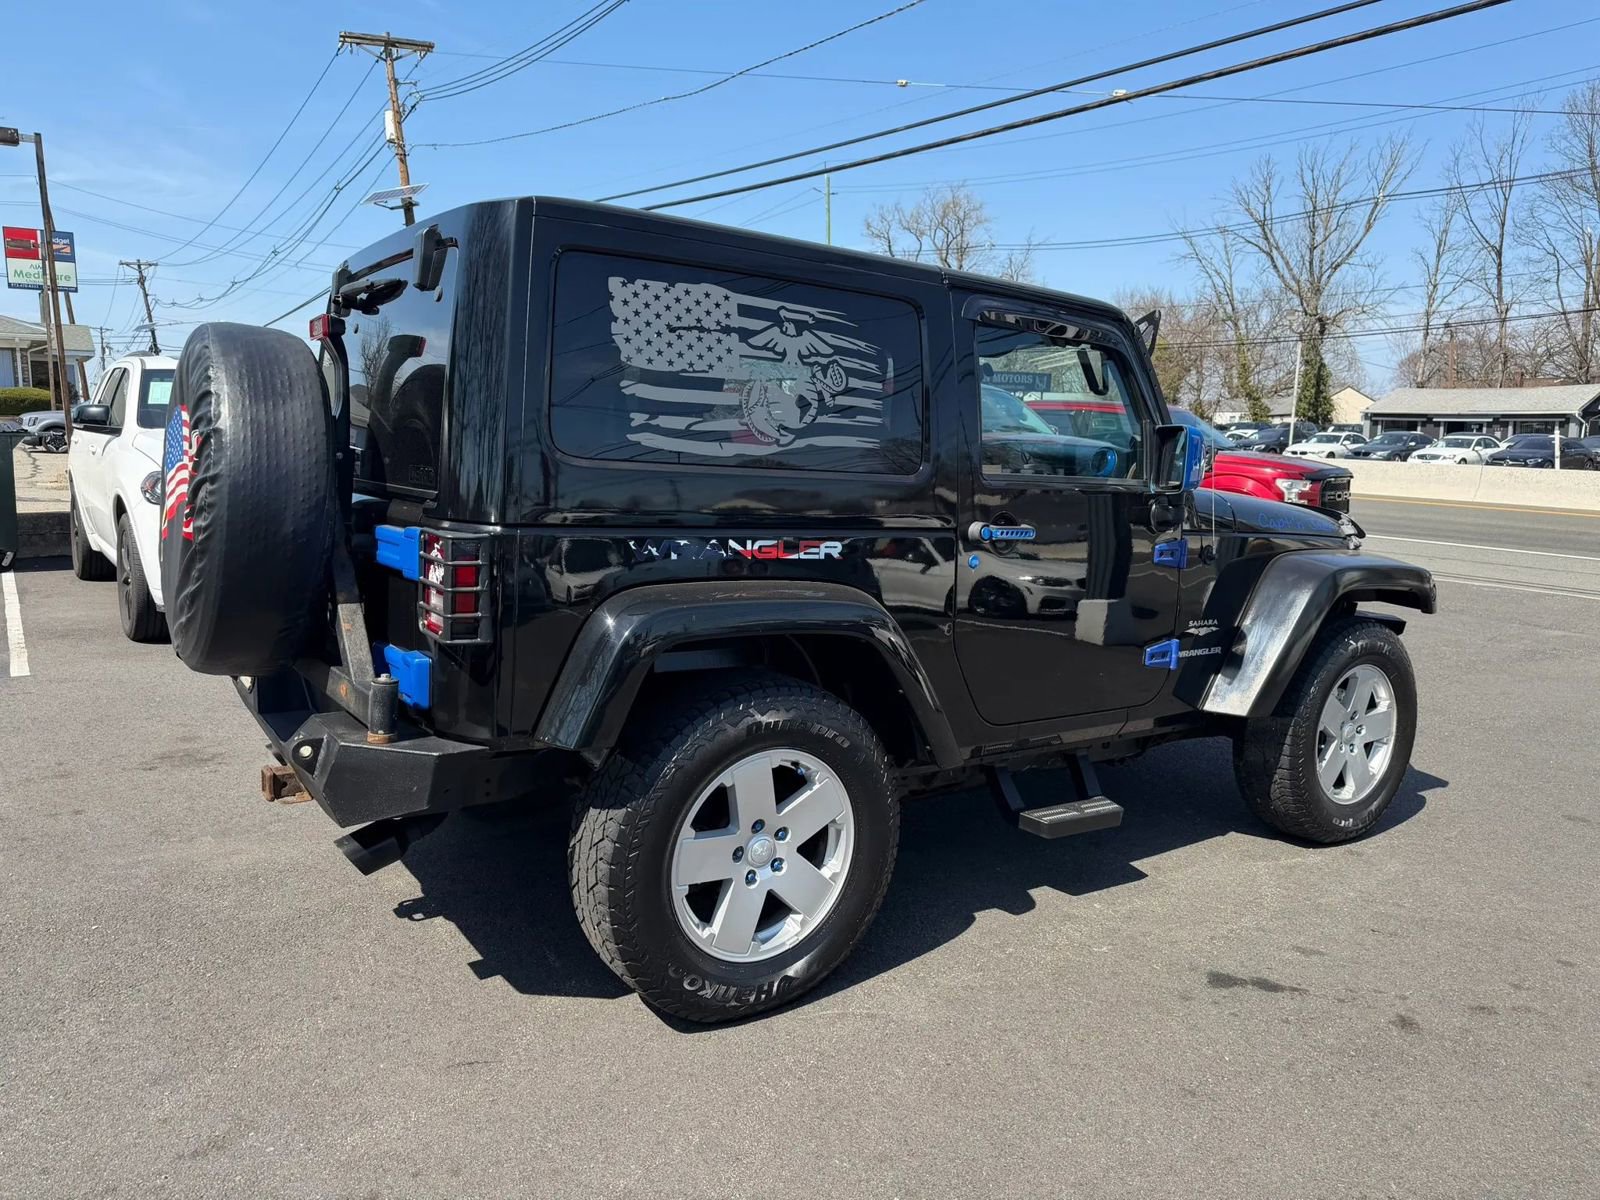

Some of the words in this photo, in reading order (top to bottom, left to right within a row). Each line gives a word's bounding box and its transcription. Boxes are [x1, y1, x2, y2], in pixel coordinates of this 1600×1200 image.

[993, 373, 1033, 384] MOTORS
[1325, 491, 1351, 501] FOR
[626, 538, 843, 560] WRANGLER
[1187, 619, 1218, 627] SAHARA
